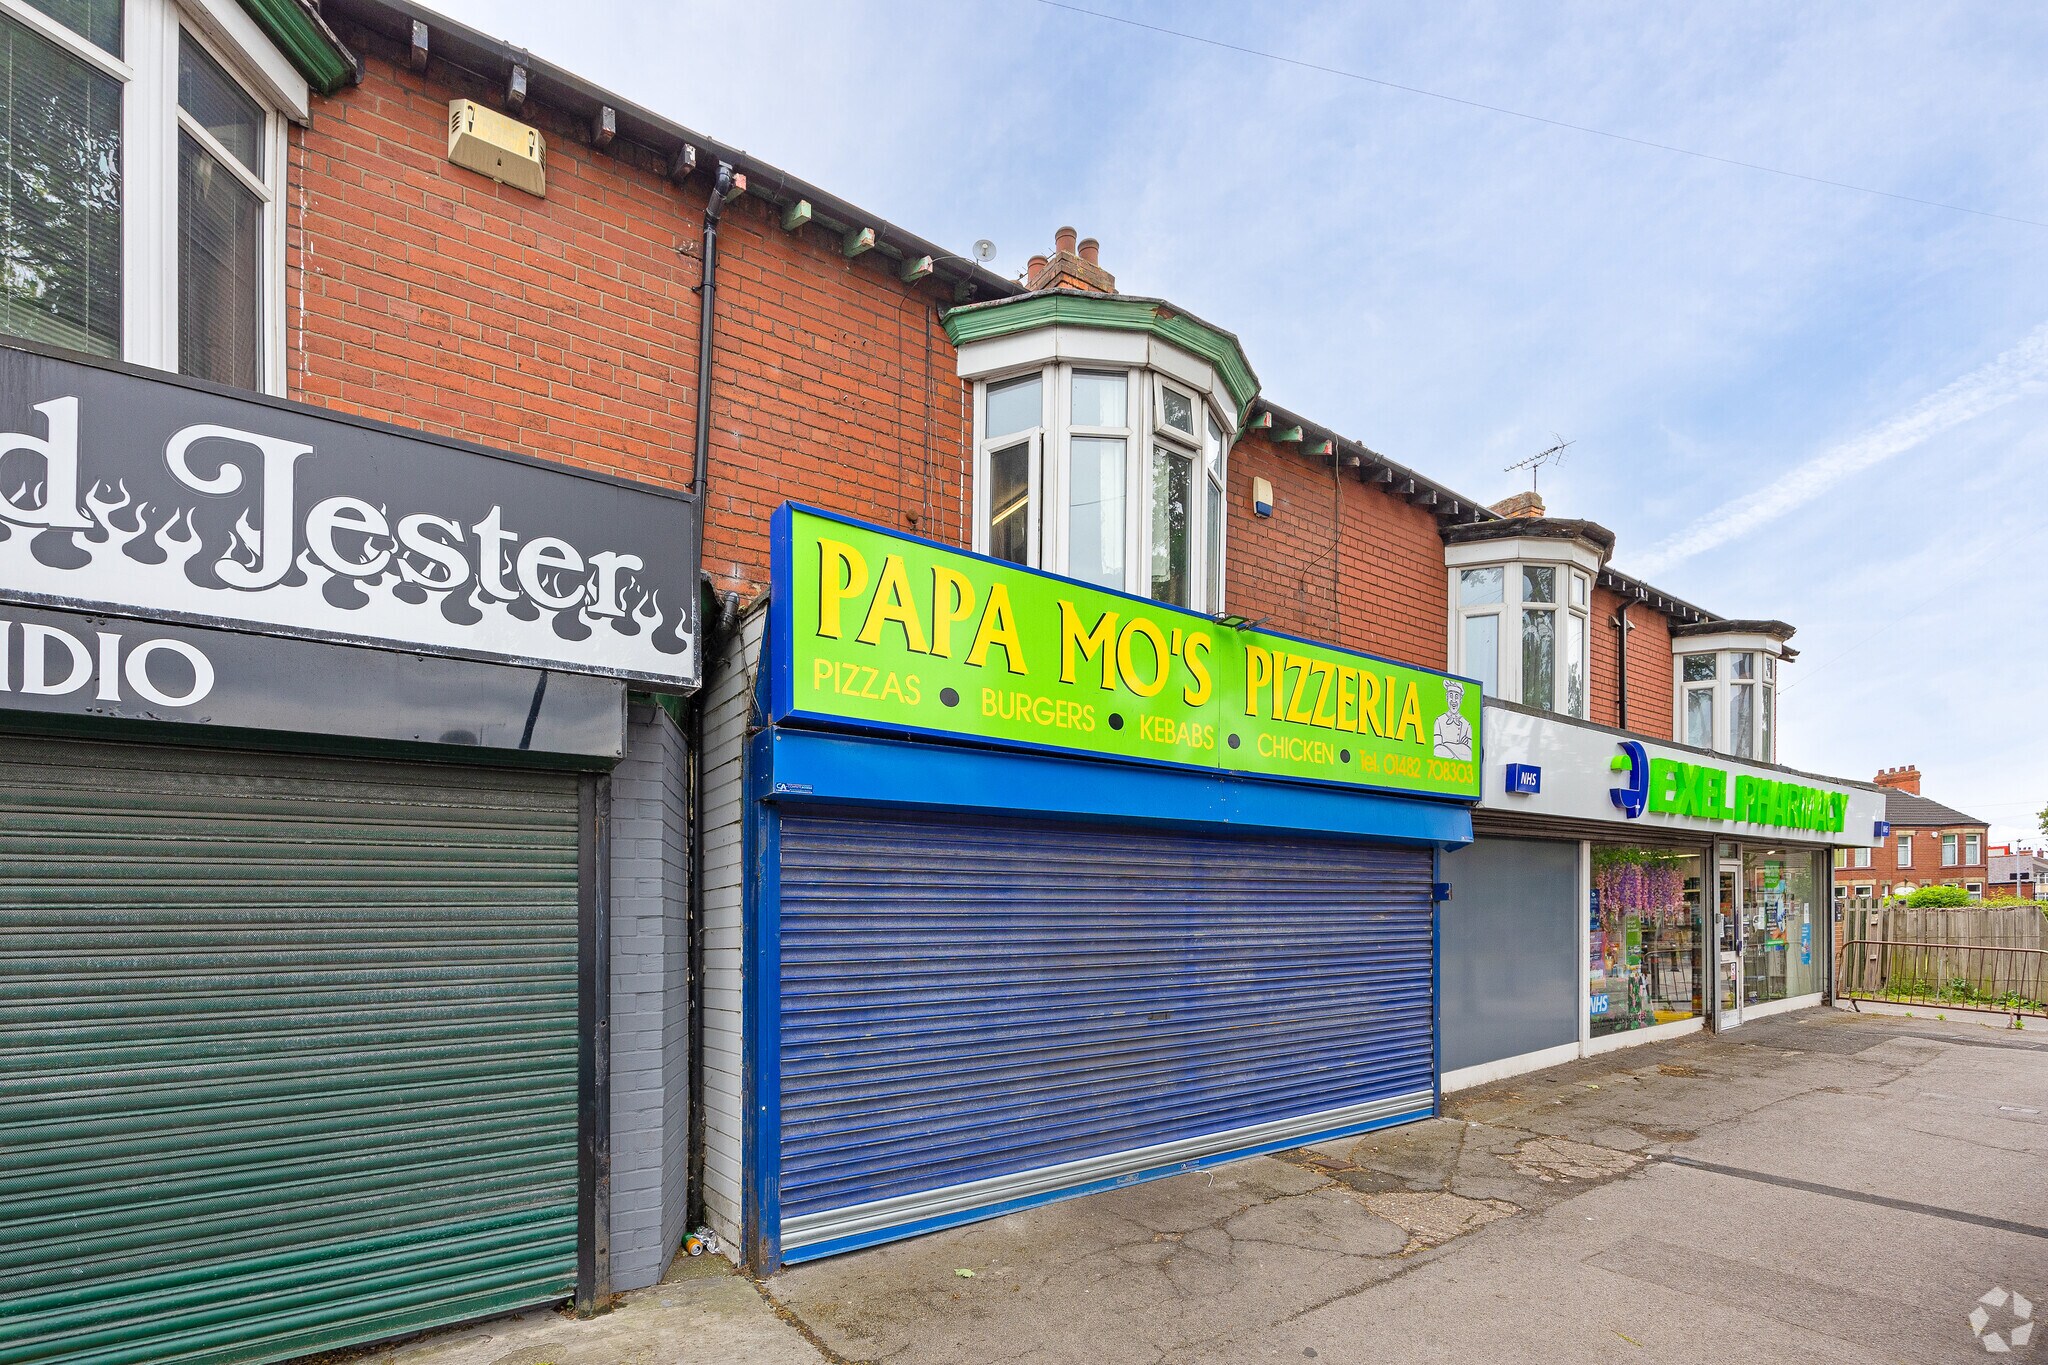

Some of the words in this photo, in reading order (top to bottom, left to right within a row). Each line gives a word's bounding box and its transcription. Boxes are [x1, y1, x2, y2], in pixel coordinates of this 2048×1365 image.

[167, 424, 643, 617] Jester
[816, 537, 1029, 675] PAPA
[1057, 599, 1213, 707] MO'S
[1244, 645, 1427, 745] PIZZERIA
[813, 658, 922, 706] PIZZAS
[981, 687, 1096, 733] BURGERS
[1139, 714, 1216, 751] KEBABS
[1257, 732, 1335, 765] CHICKEN
[1383, 753, 1421, 779] 01482
[1426, 759, 1474, 784] 708303
[1520, 771, 1537, 786] NHS
[1648, 757, 1735, 821] EXEL
[1735, 774, 1850, 833] PHARMACY
[1590, 994, 1609, 1013] NHS
